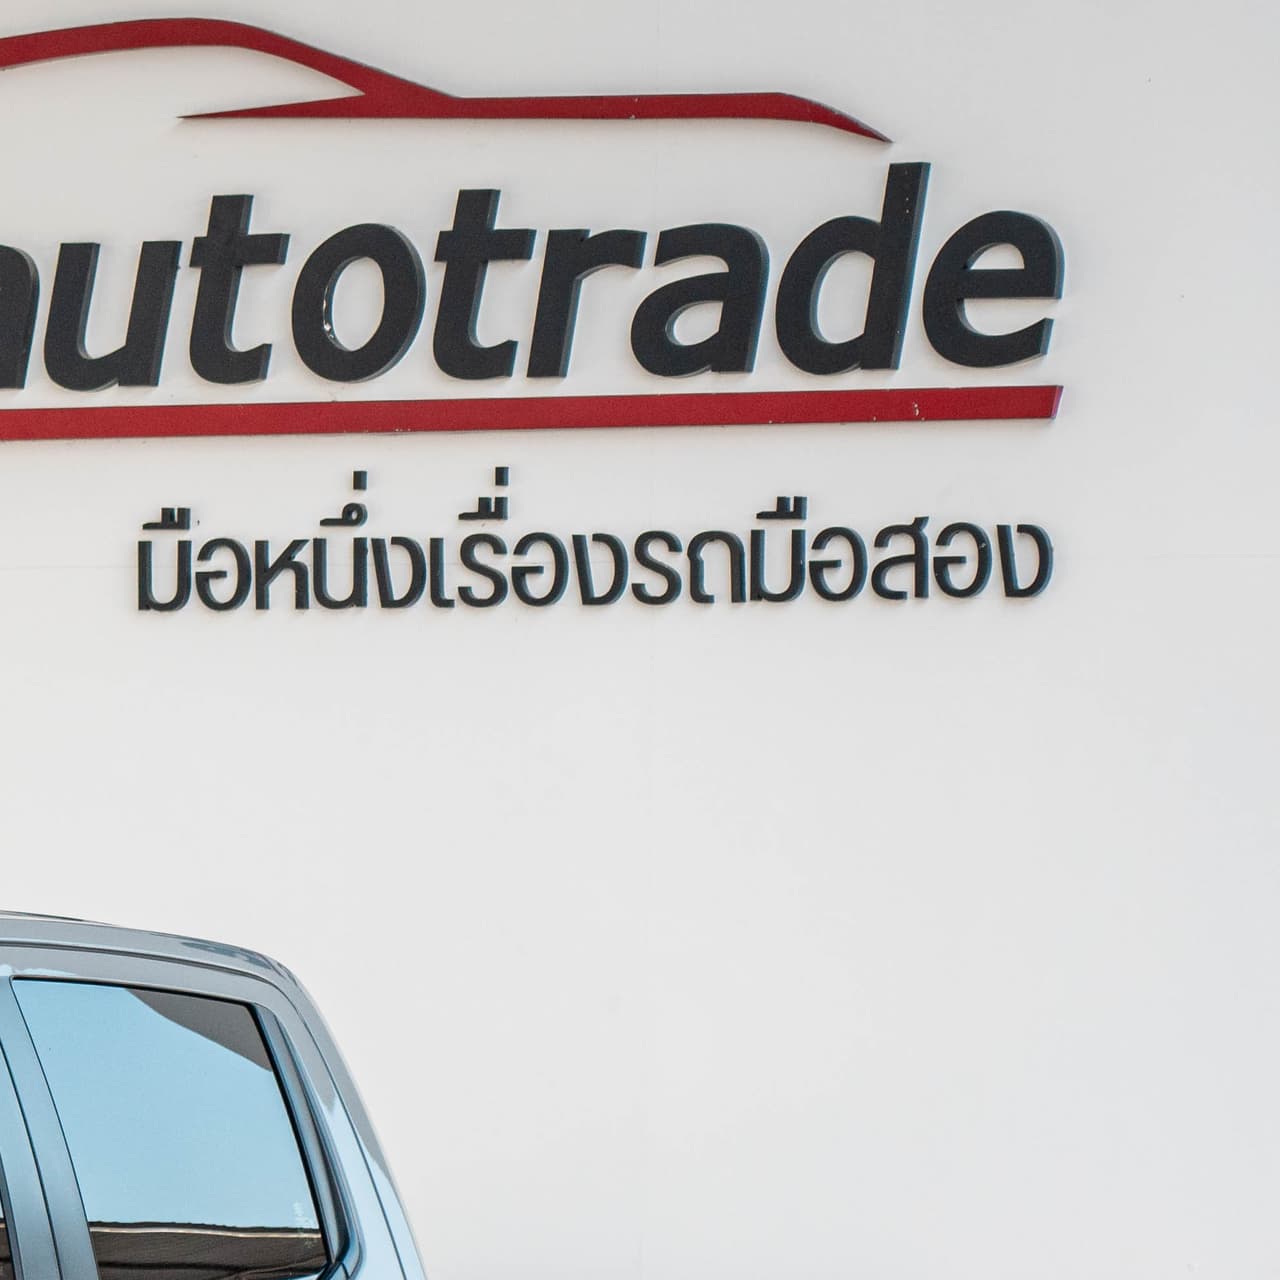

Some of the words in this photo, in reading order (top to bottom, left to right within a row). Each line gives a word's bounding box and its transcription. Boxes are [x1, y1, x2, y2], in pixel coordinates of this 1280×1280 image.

[137, 466, 1055, 612] มือหนึ่งเรื่องรถมือสอง
